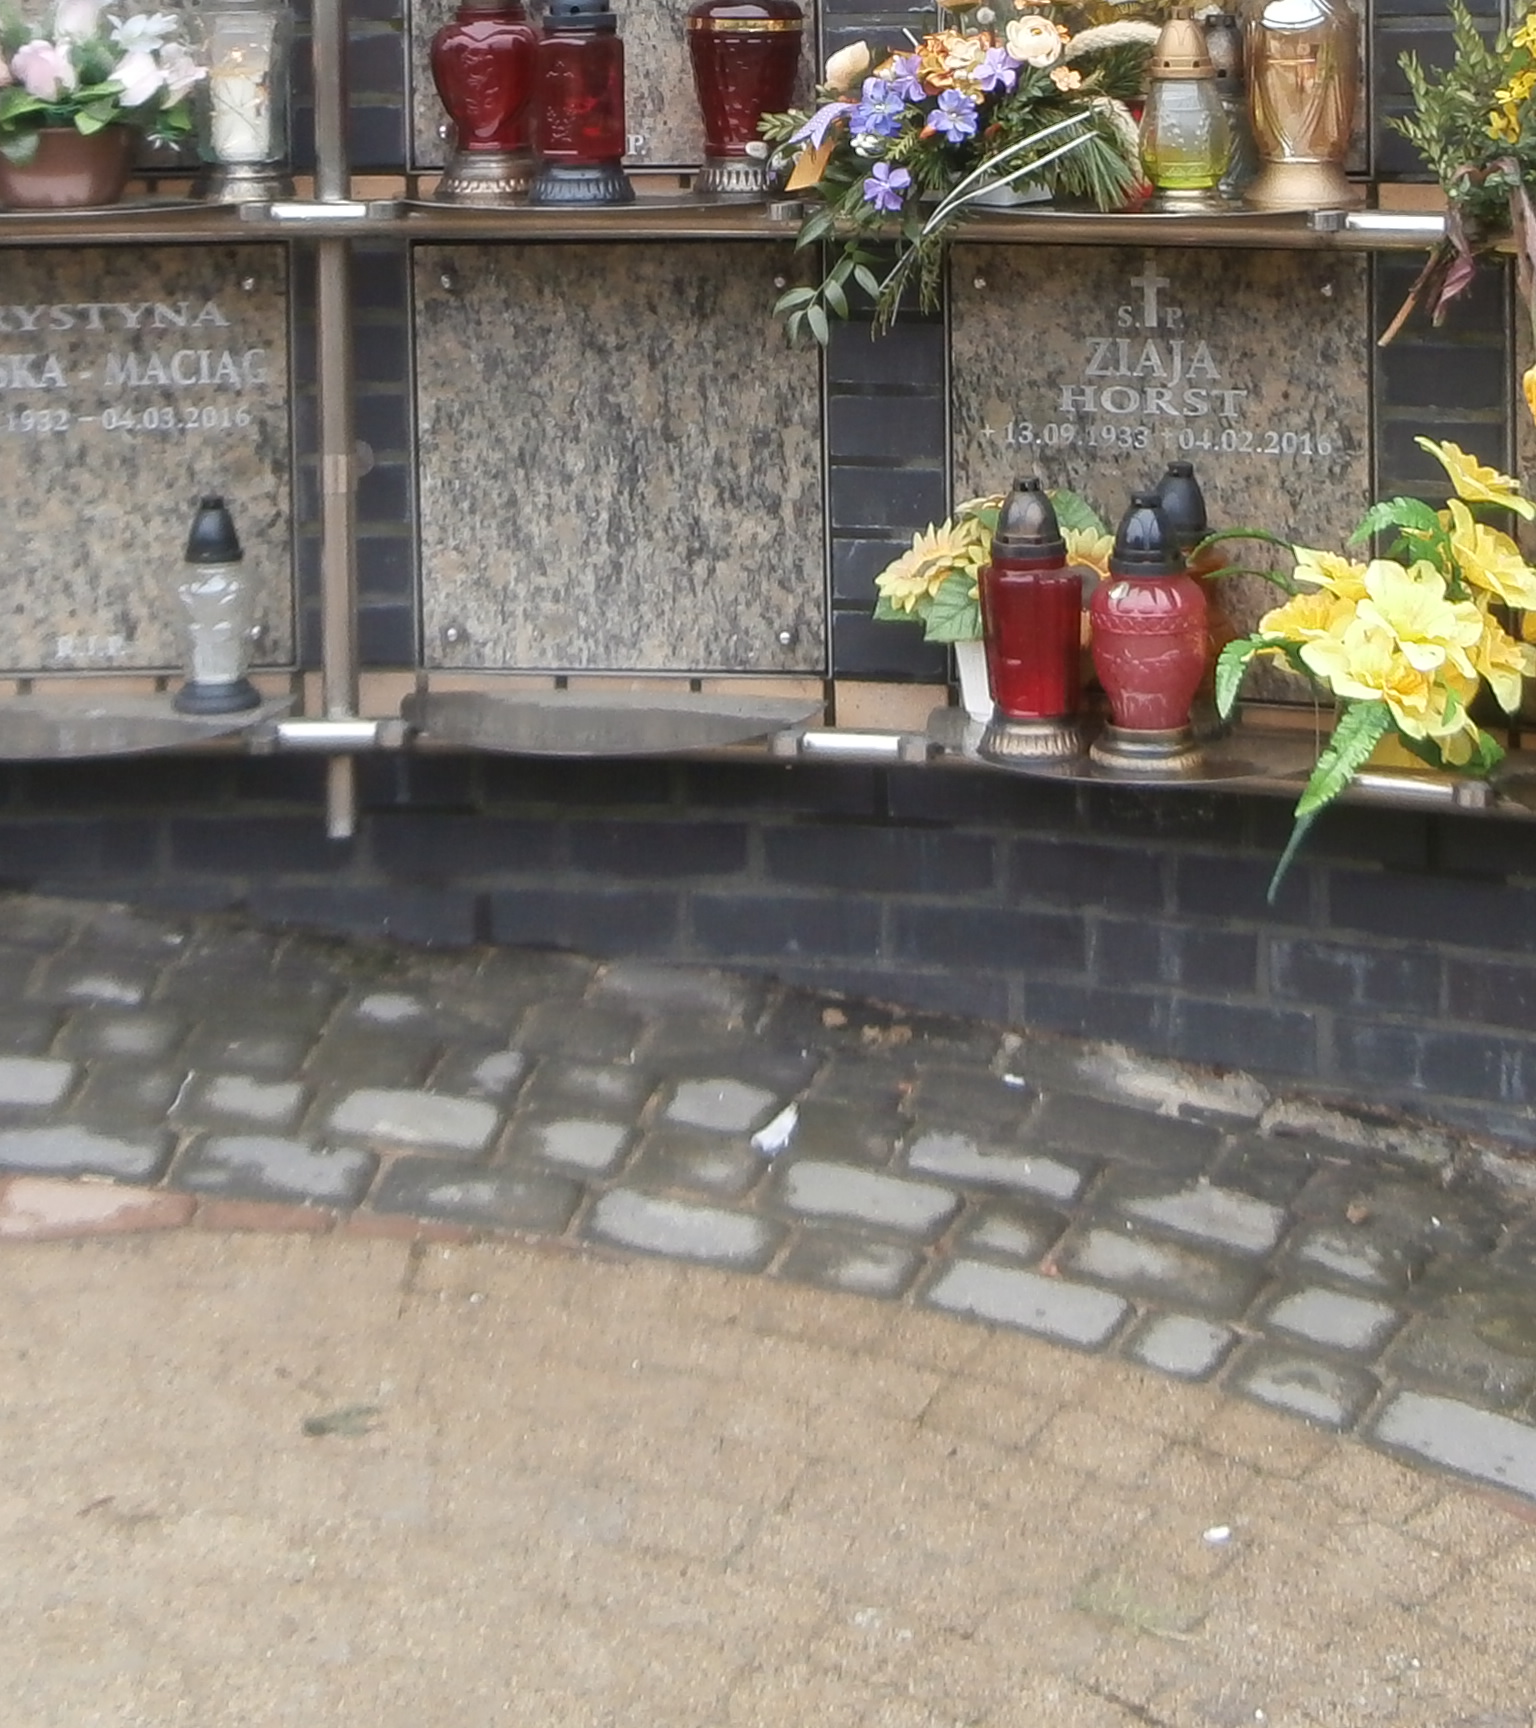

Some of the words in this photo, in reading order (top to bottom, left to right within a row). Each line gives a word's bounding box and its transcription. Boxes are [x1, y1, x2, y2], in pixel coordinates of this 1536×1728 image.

[1084, 337, 1221, 388] ZIAJA
[1058, 385, 1248, 417] HORST
[1179, 429, 1332, 456] 04.02.2016
